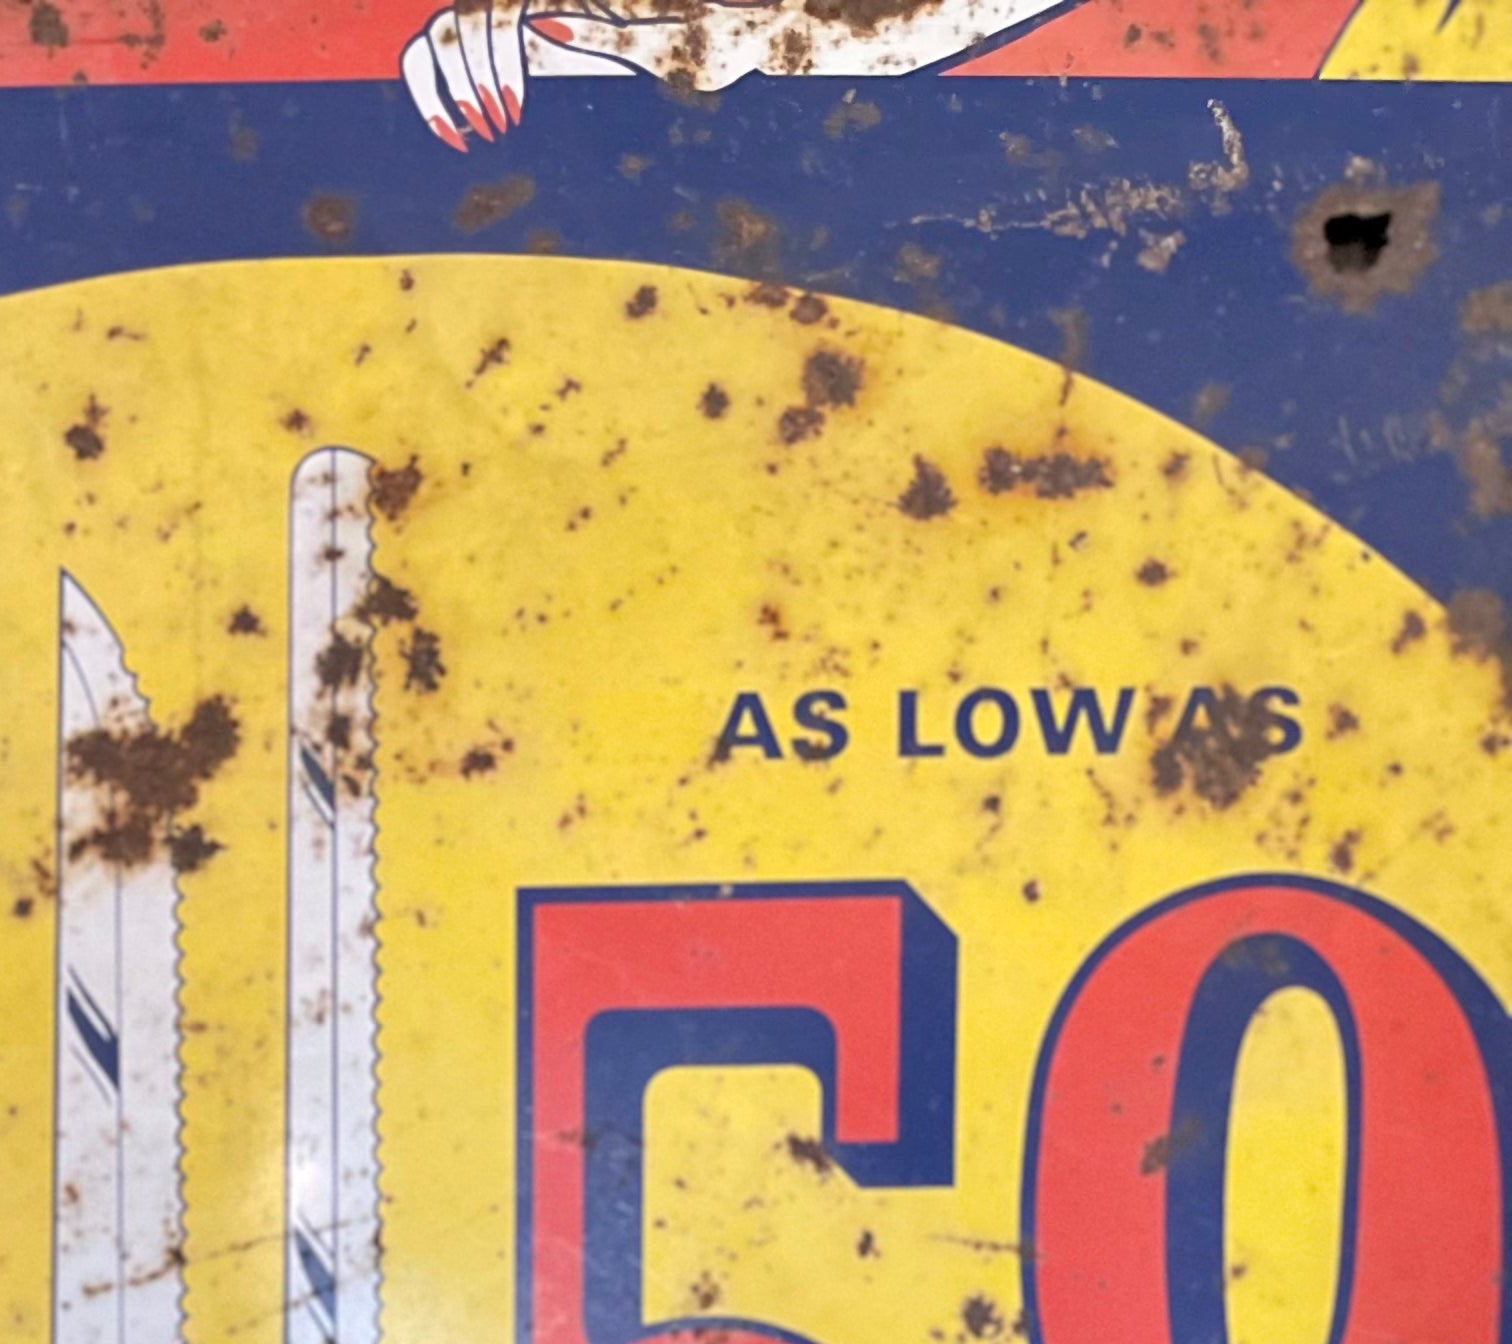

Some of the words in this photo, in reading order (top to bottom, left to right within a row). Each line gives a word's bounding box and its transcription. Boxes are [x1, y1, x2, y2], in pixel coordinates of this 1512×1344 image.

[709, 690, 849, 760] AS
[898, 687, 1136, 758] LOW
[1160, 686, 1304, 758] AS
